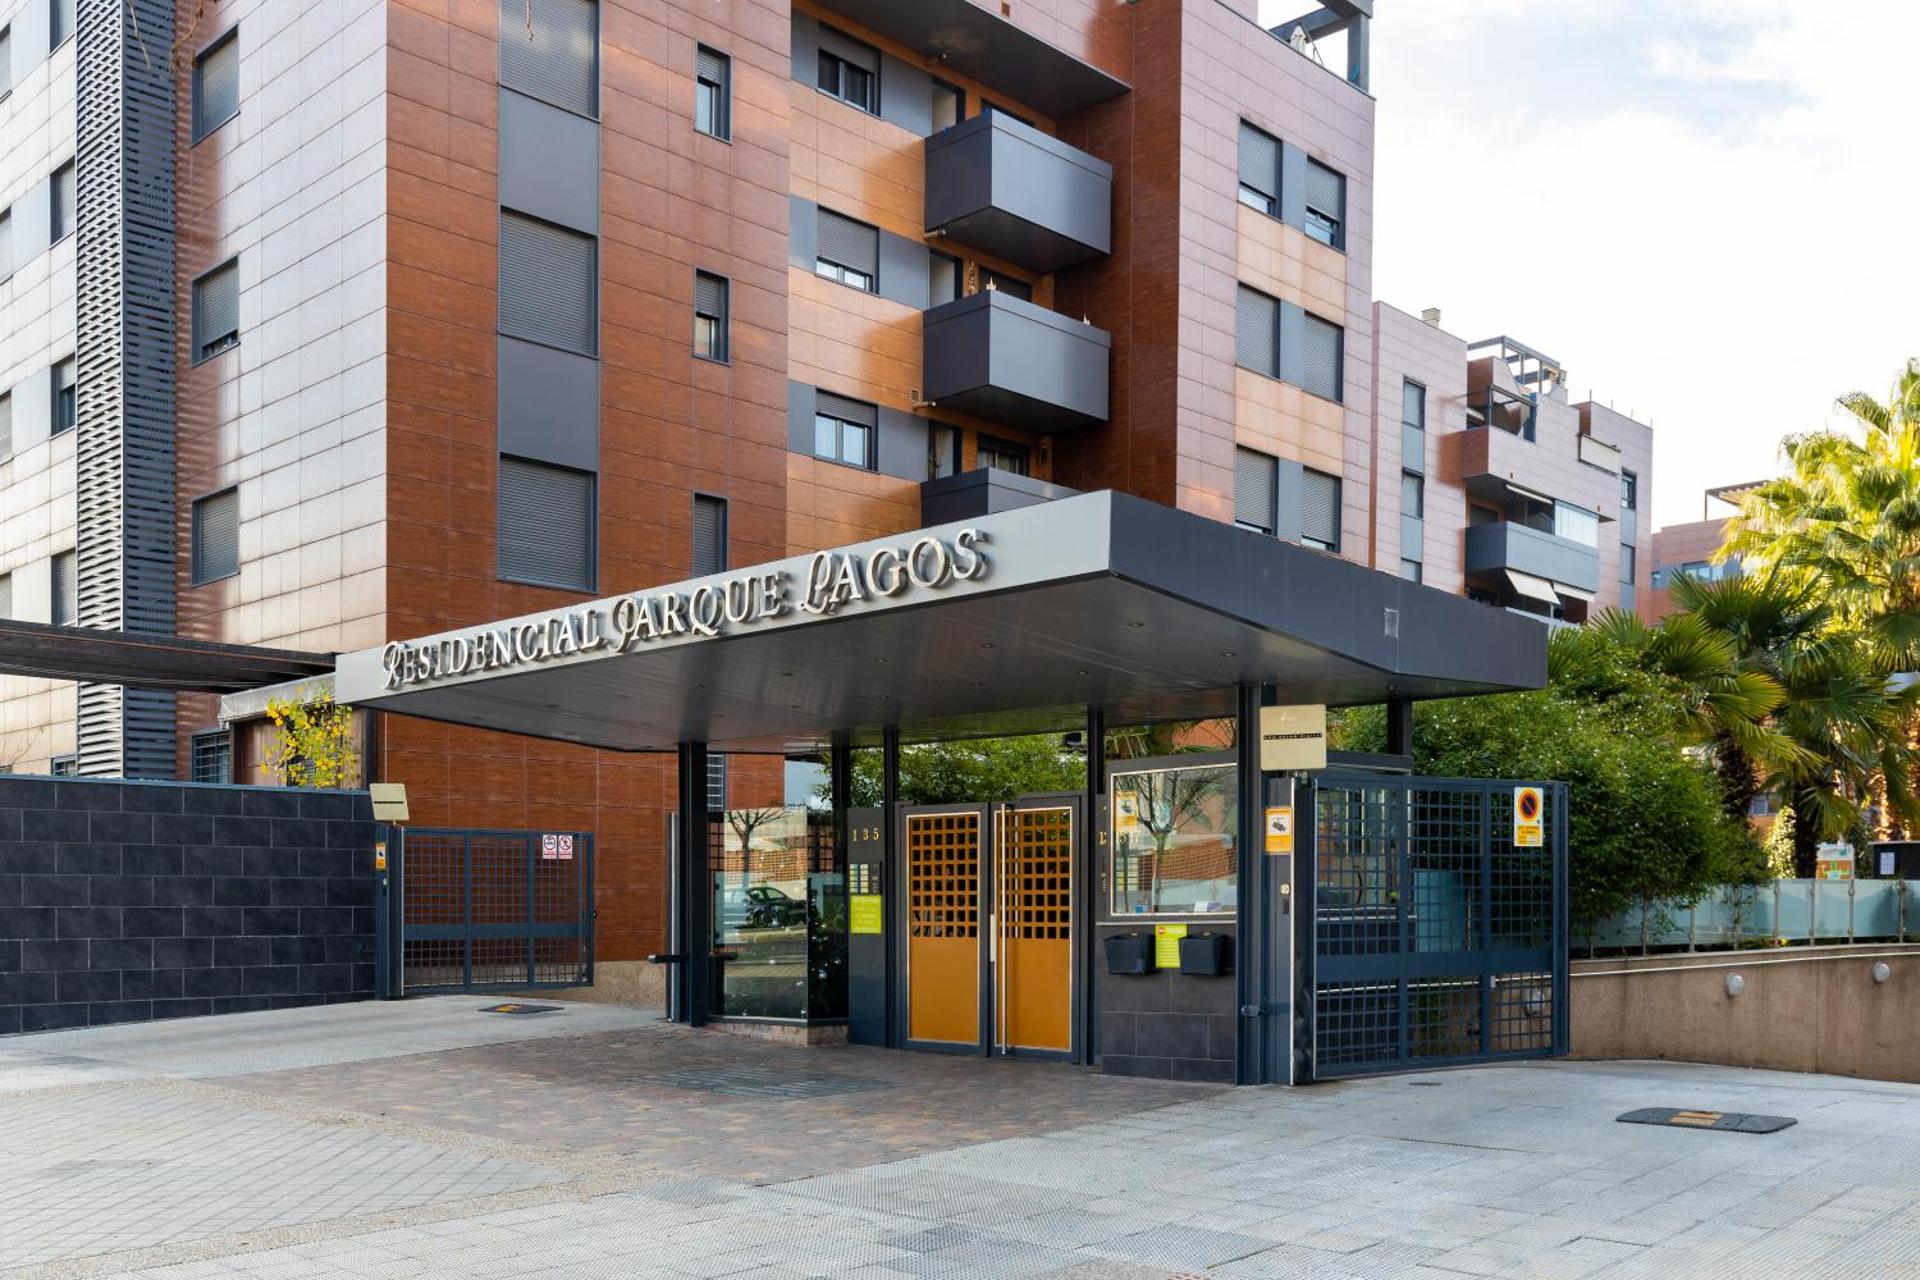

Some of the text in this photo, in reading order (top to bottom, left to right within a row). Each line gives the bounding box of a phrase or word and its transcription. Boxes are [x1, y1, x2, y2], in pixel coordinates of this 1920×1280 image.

[382, 528, 988, 690] RESIDENCIAL PARQUE LAGOS
